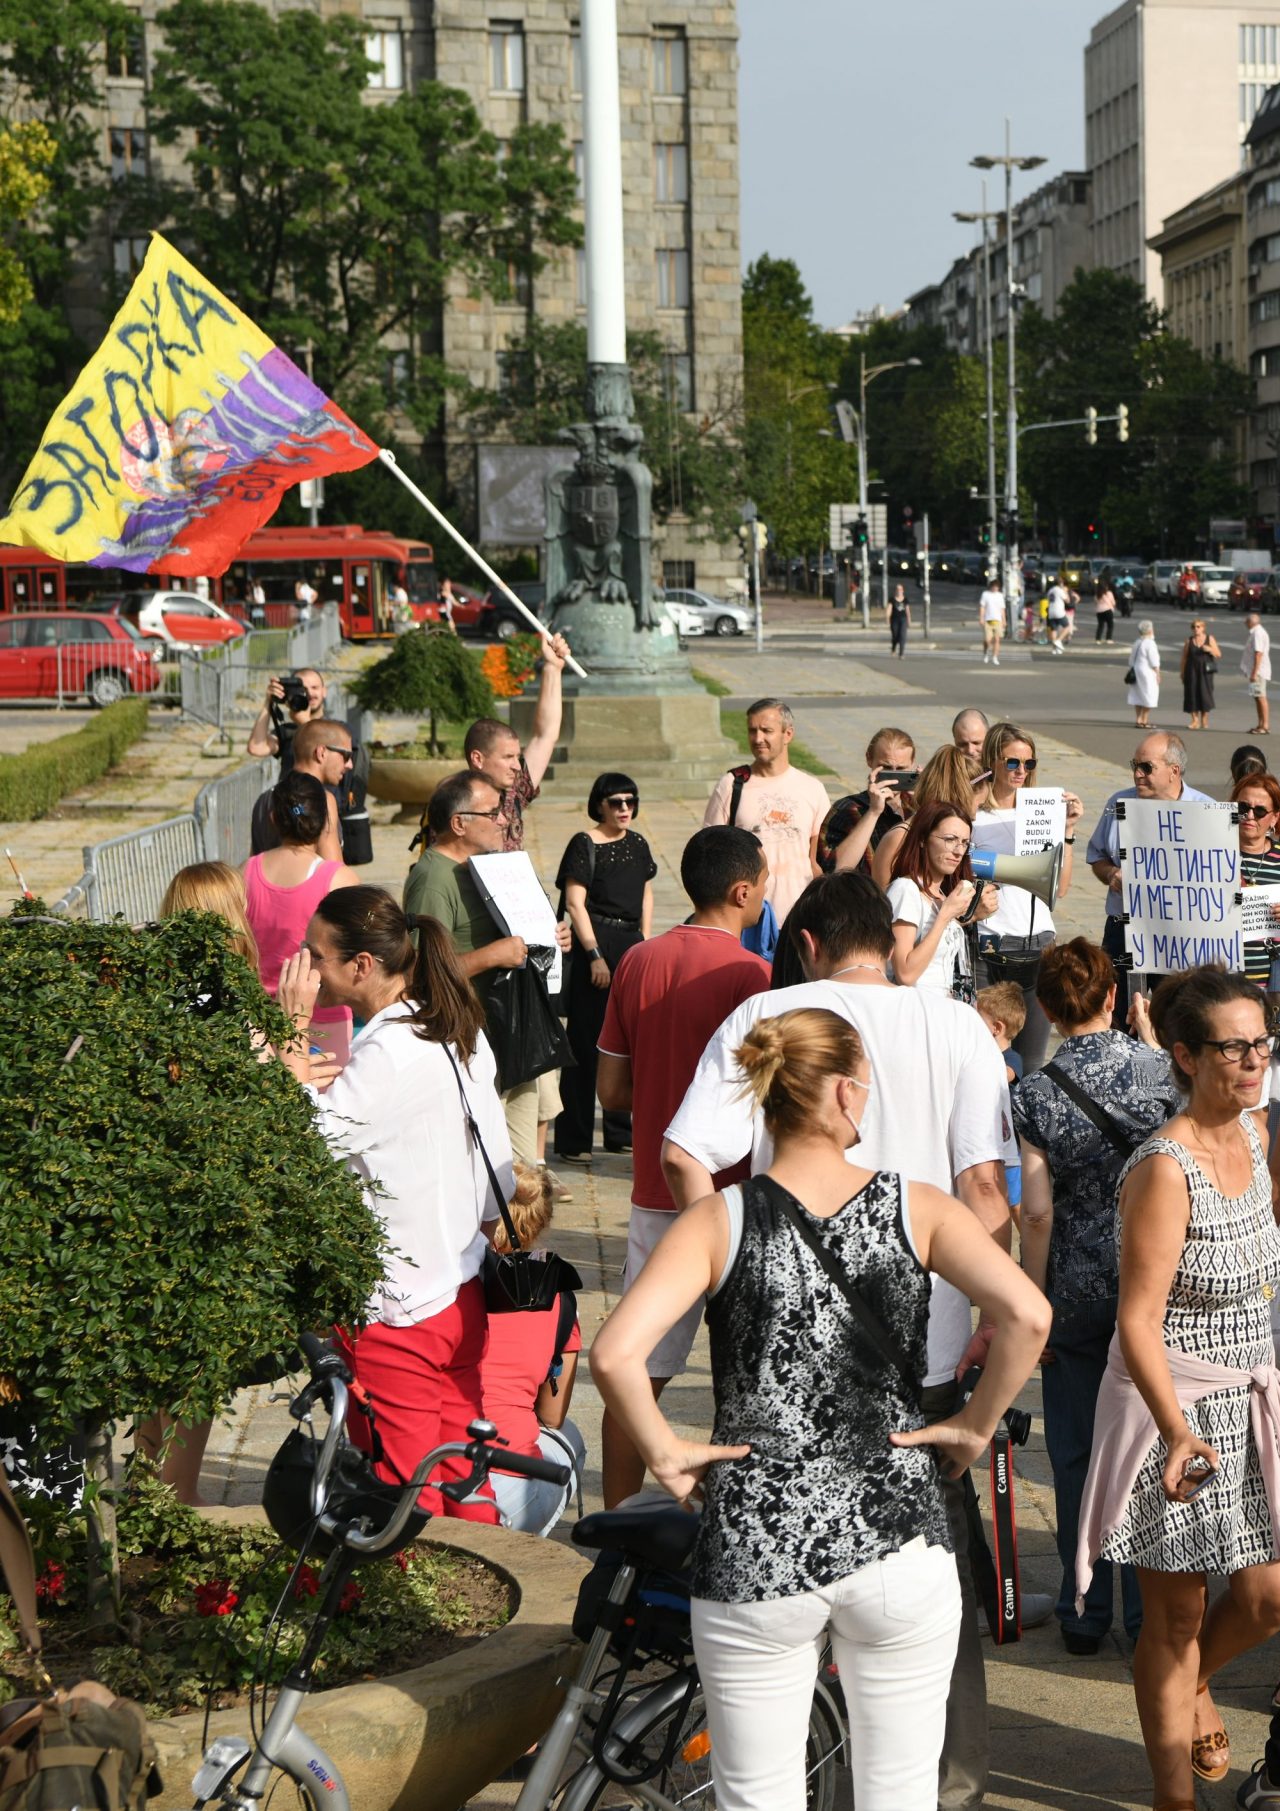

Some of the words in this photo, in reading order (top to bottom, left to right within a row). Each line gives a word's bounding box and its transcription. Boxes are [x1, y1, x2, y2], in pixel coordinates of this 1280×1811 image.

[10, 268, 238, 535] ЗАГОРКА
[1024, 798, 1055, 806] TRAŽIMO
[1157, 810, 1186, 842] НЕ
[1132, 846, 1169, 881] РИО
[1173, 847, 1236, 883] ТИНТУ
[1128, 883, 1143, 918] И
[1147, 884, 1224, 922] МЕТРОУ
[1132, 933, 1145, 968] У
[997, 1453, 1006, 1494] Canon
[1004, 1577, 1015, 1621] Canon
